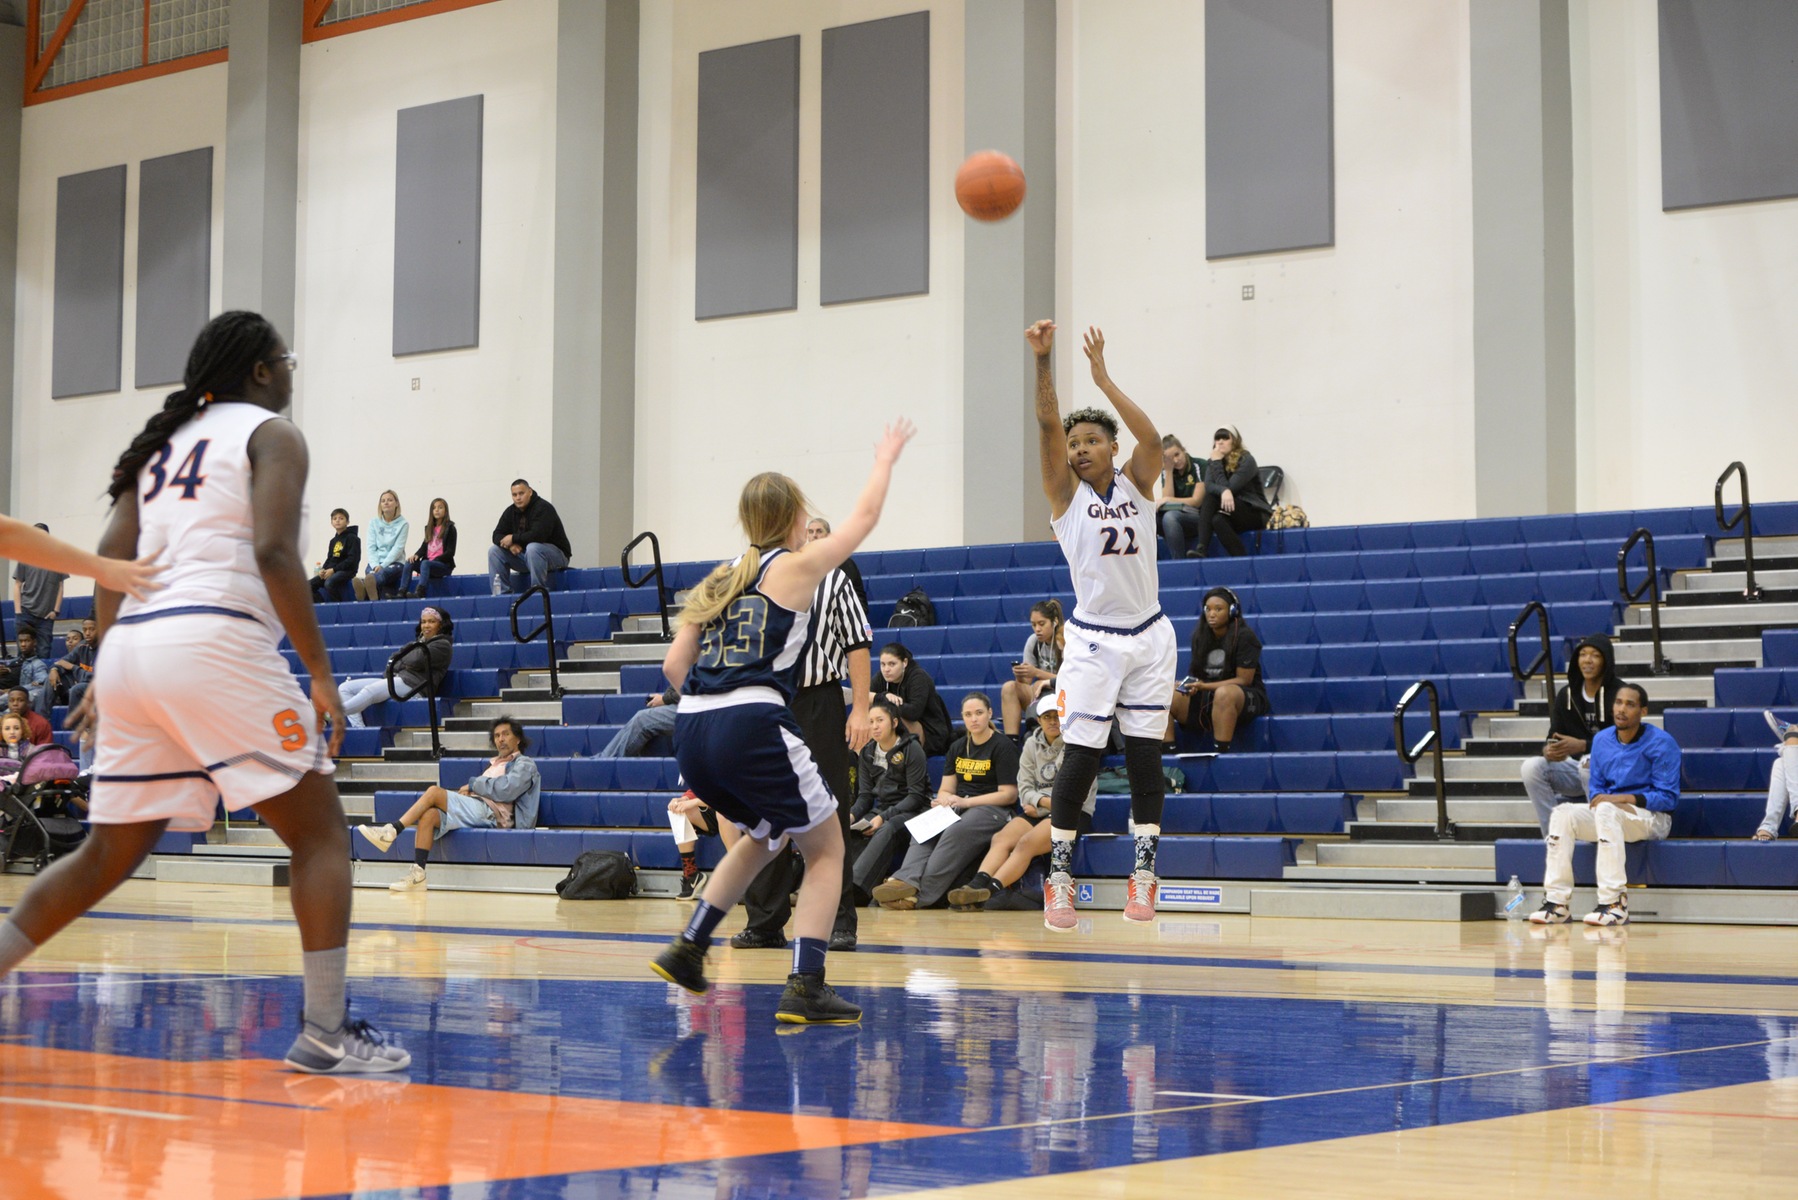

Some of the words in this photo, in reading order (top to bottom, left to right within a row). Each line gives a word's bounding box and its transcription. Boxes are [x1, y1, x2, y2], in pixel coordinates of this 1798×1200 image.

[143, 438, 212, 505] 34
[1087, 500, 1139, 520] GIANTS
[1099, 526, 1140, 556] 22
[700, 594, 769, 668] 33
[272, 708, 308, 752] S
